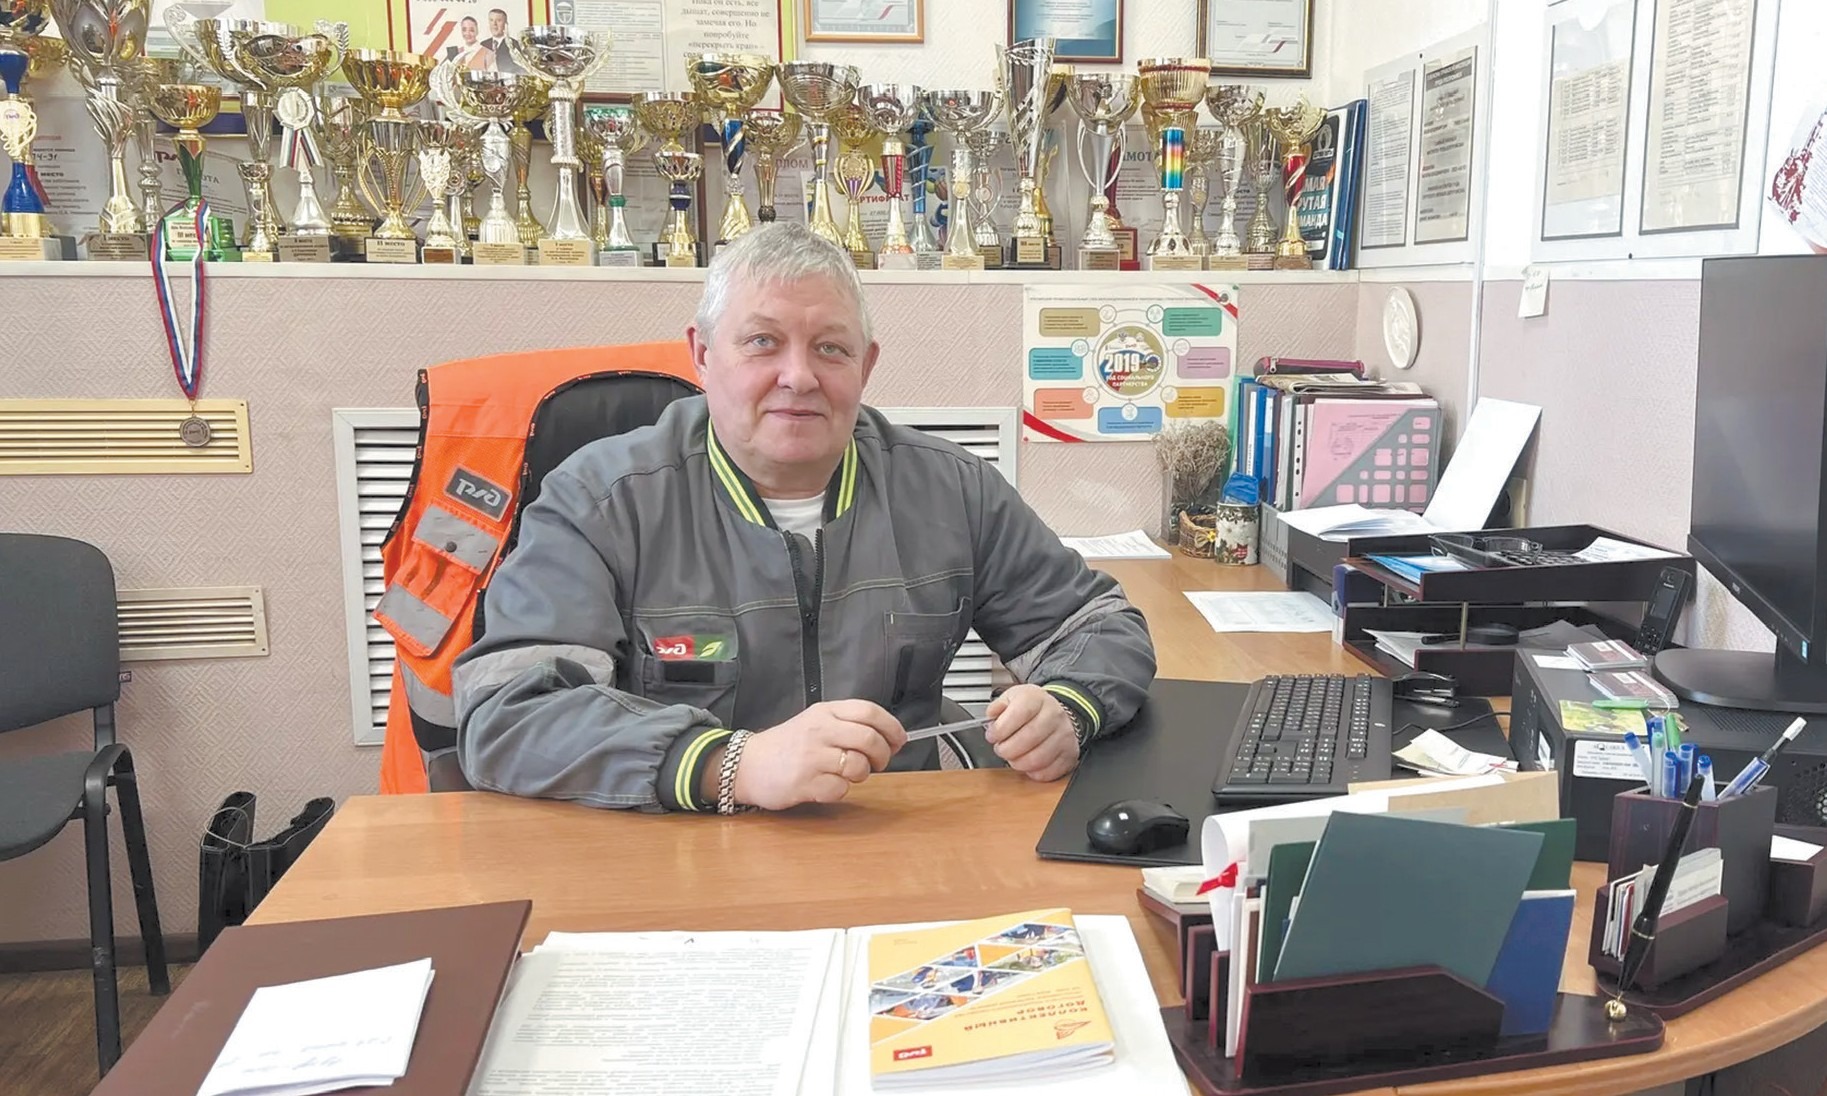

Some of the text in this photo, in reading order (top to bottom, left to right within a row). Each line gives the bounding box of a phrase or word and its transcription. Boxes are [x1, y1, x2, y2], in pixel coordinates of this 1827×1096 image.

[1104, 353, 1140, 373] 2019
[456, 478, 501, 507] РЖД
[963, 1007, 1088, 1031] КОЛЛЕКТИВНЫЙ
